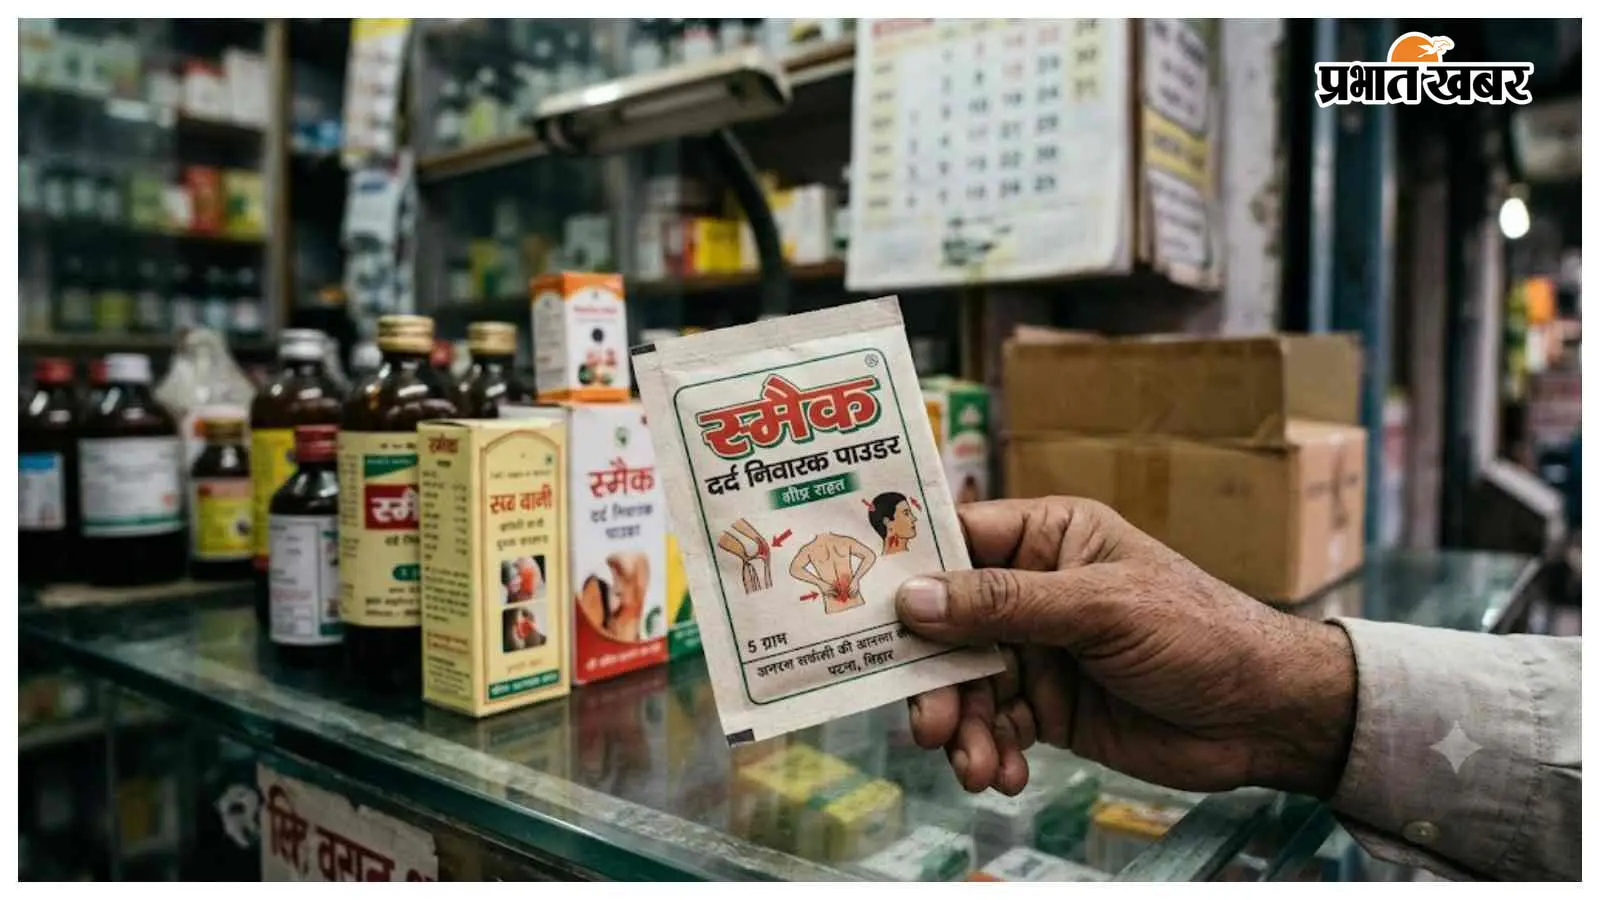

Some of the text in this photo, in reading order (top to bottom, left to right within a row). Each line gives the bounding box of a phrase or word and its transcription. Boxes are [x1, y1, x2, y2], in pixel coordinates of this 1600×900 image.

[697, 374, 880, 460] स्मैक
[587, 456, 655, 498] स्मैक
[705, 435, 902, 496] दर्द निवारक पाउडर
[747, 632, 789, 654] 5 ग्राम
